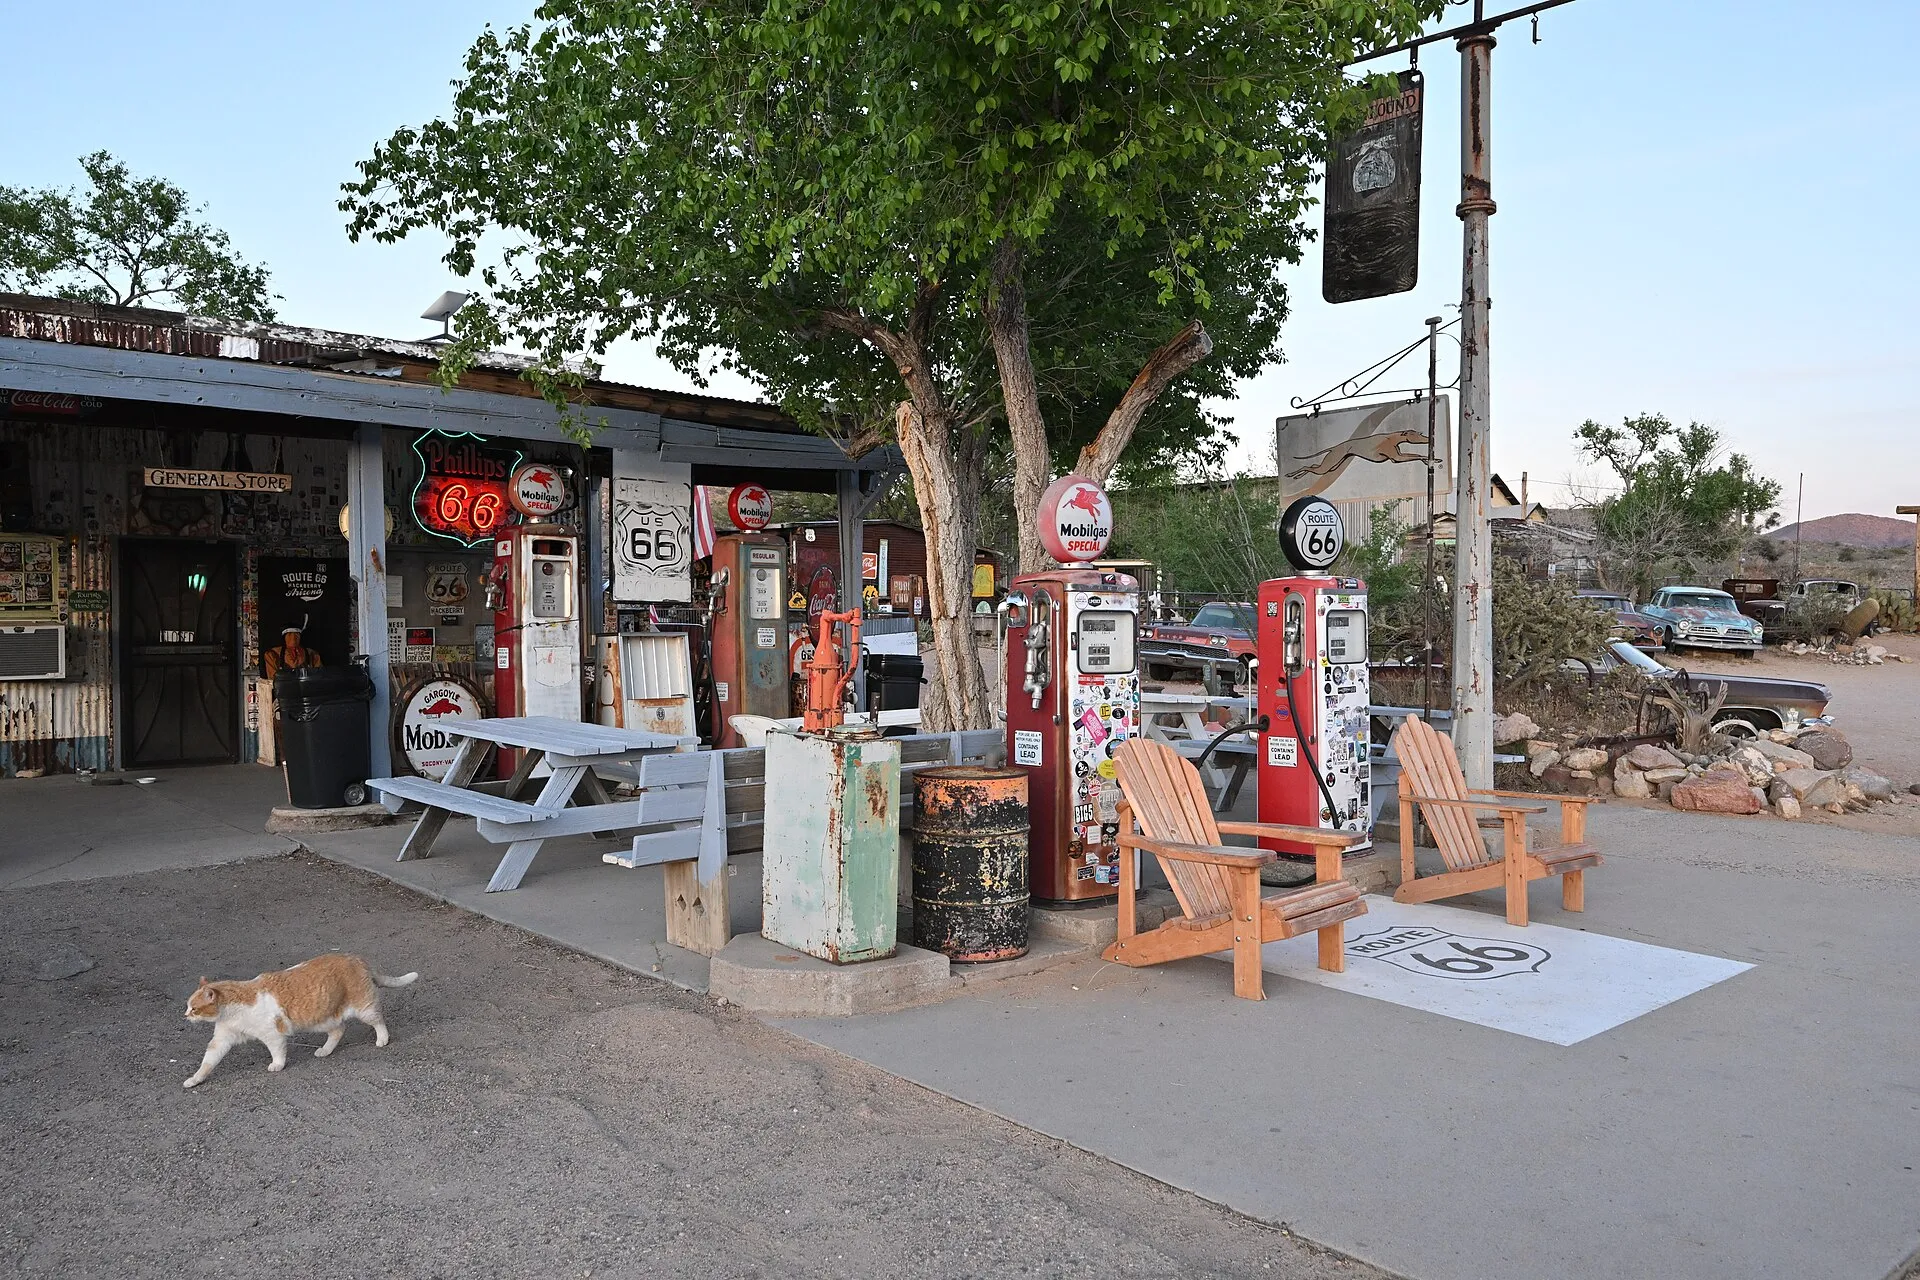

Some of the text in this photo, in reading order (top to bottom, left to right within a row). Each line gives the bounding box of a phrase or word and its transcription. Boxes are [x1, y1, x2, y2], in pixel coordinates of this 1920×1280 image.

[425, 439, 506, 484] Phillips
[150, 470, 287, 489] GENERAL STORE
[521, 489, 559, 503] Mobilgas
[436, 482, 501, 531] 66
[527, 501, 553, 510] SPECIAL
[740, 507, 769, 519] Mobilgas
[744, 517, 765, 525] SPECIAL
[1308, 515, 1334, 523] ROUTE
[1060, 523, 1108, 541] Mobilgas
[631, 528, 676, 561] 66
[1067, 541, 1100, 551] SPECIAL
[1309, 528, 1335, 555] 66
[282, 572, 328, 584] ROUTE 66
[434, 576, 466, 597] 66
[424, 689, 460, 704] GARGOYLE
[1020, 750, 1036, 758] LEAD
[422, 759, 454, 767] SOCONY-VA
[1349, 930, 1433, 953] ROUTE
[1410, 942, 1530, 973] 66
